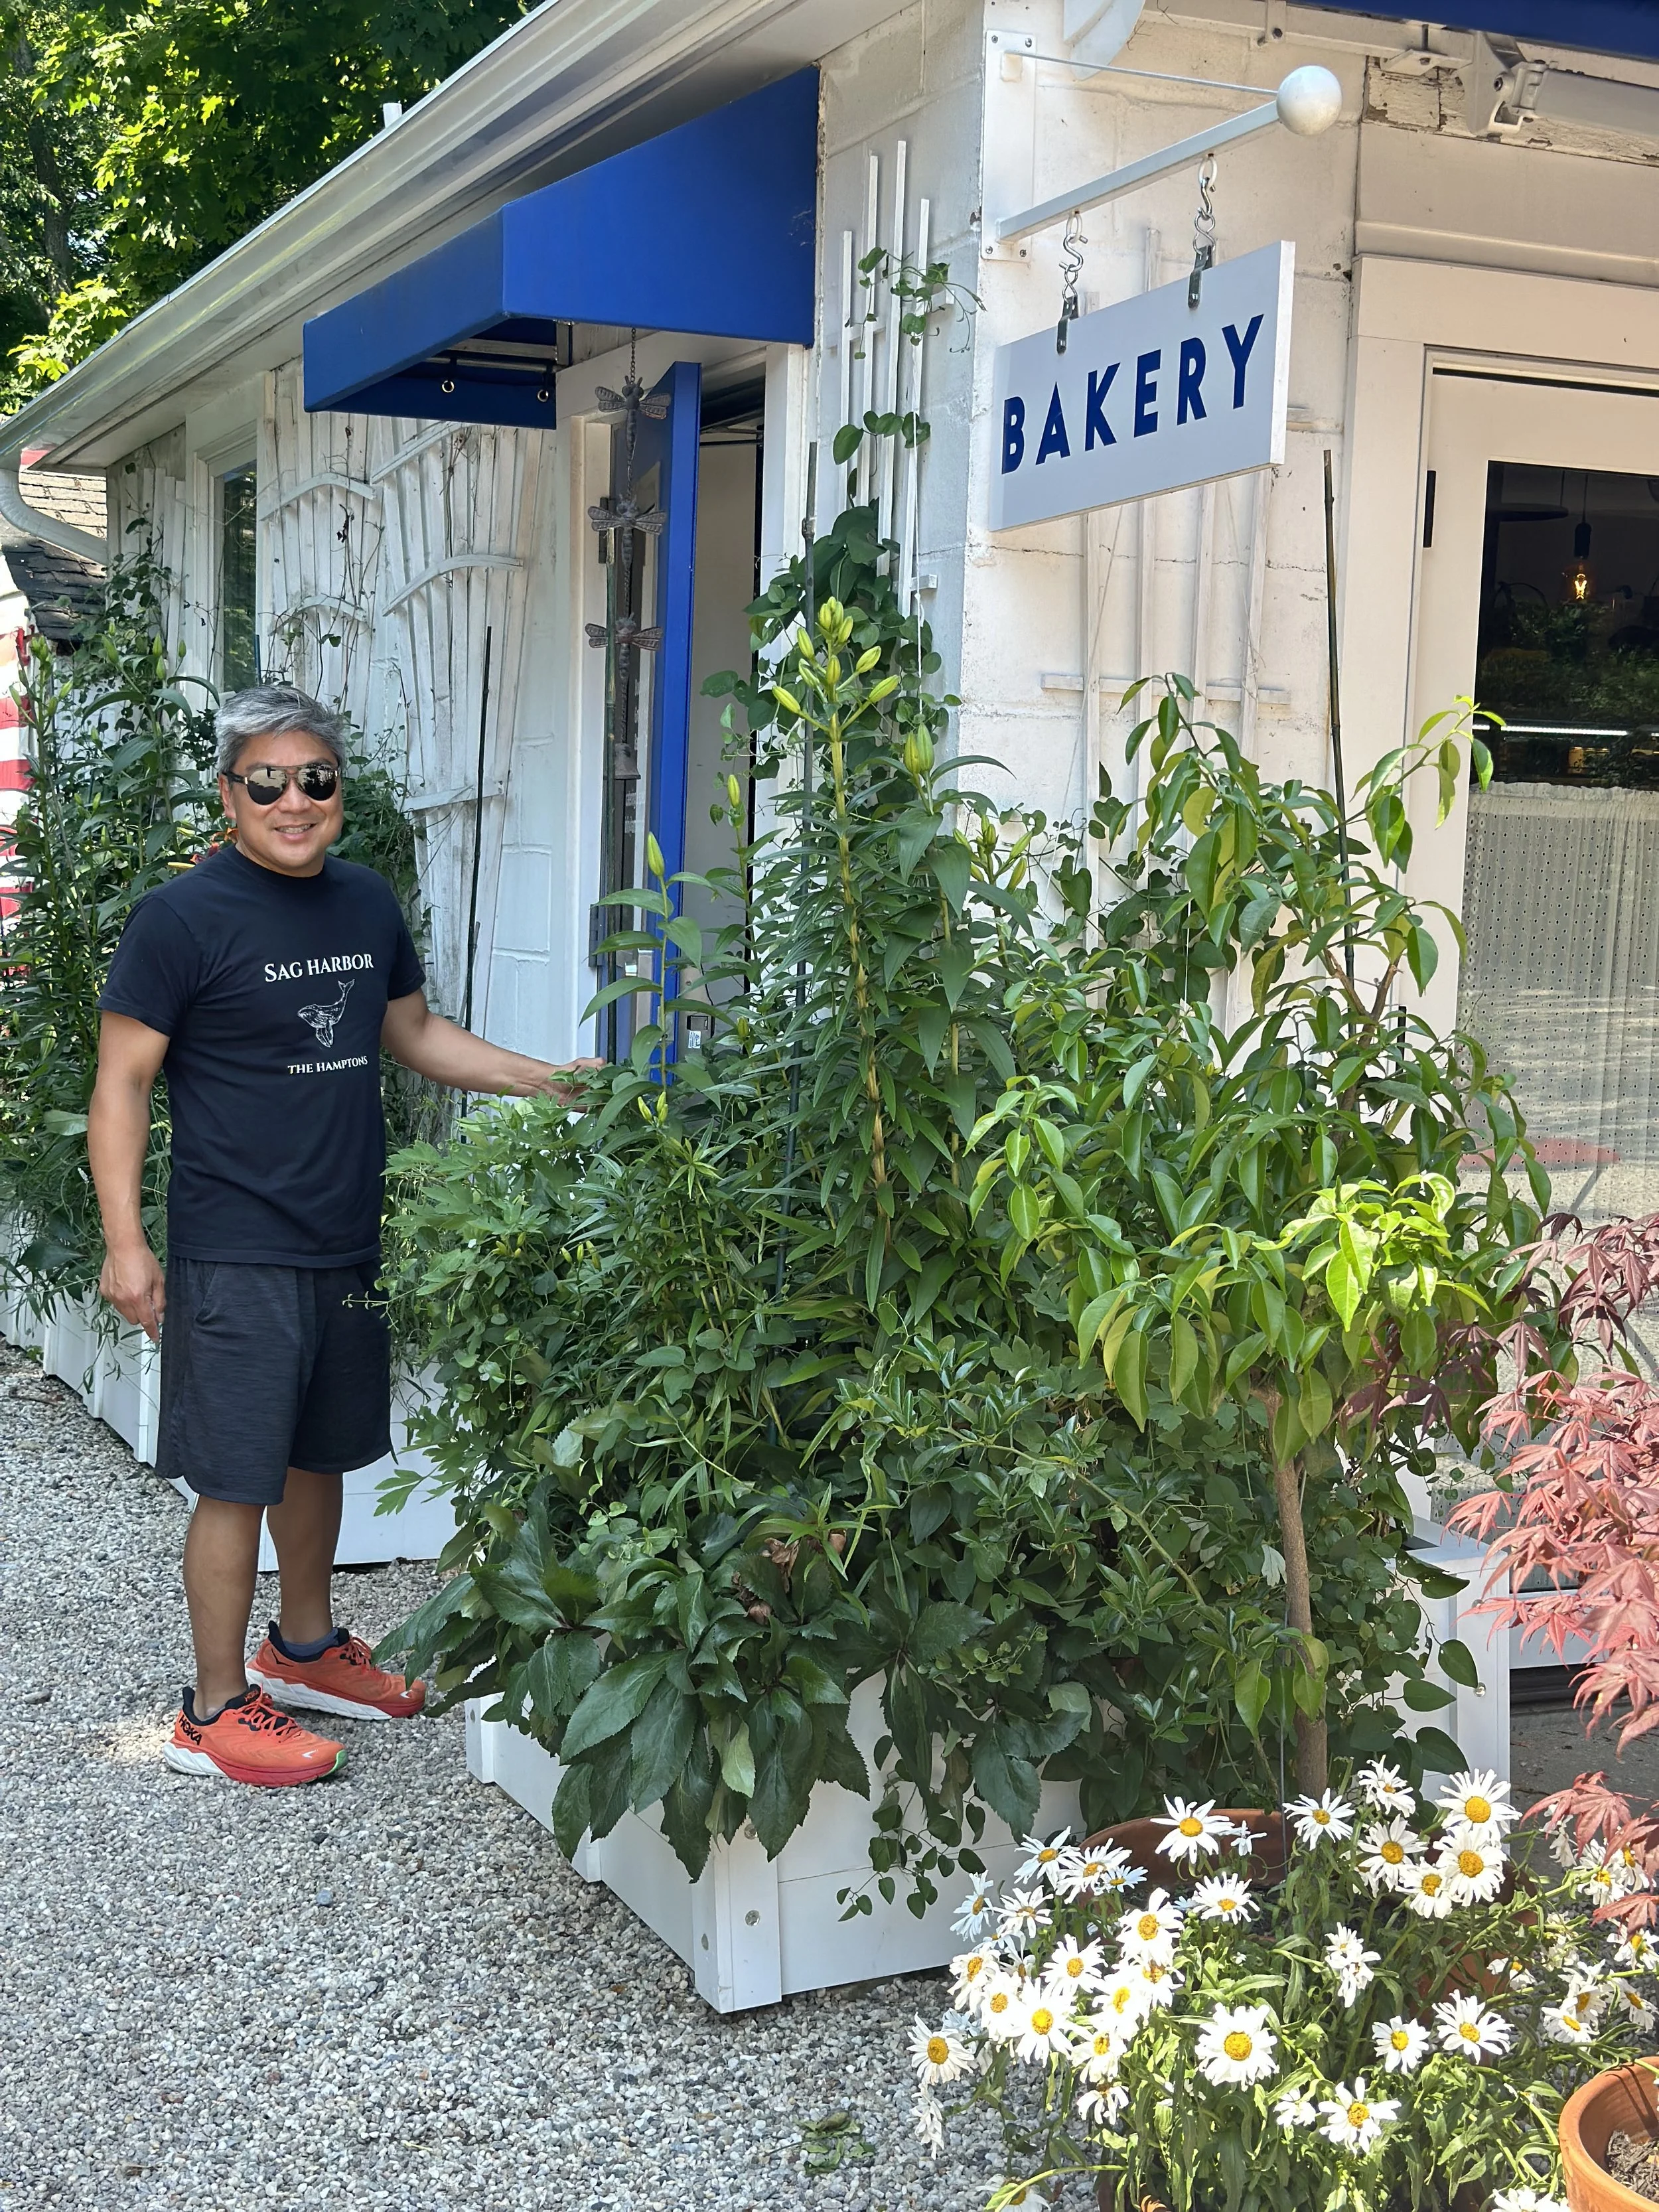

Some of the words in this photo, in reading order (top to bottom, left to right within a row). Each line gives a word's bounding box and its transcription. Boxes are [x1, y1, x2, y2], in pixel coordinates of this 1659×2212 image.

[1001, 314, 1264, 475] BAKERY
[264, 962, 303, 982] SAG
[307, 954, 374, 976] HARBOR
[287, 1063, 313, 1074] THE
[317, 1056, 368, 1072] HAMPTONS
[179, 1714, 202, 1745] HOKA
